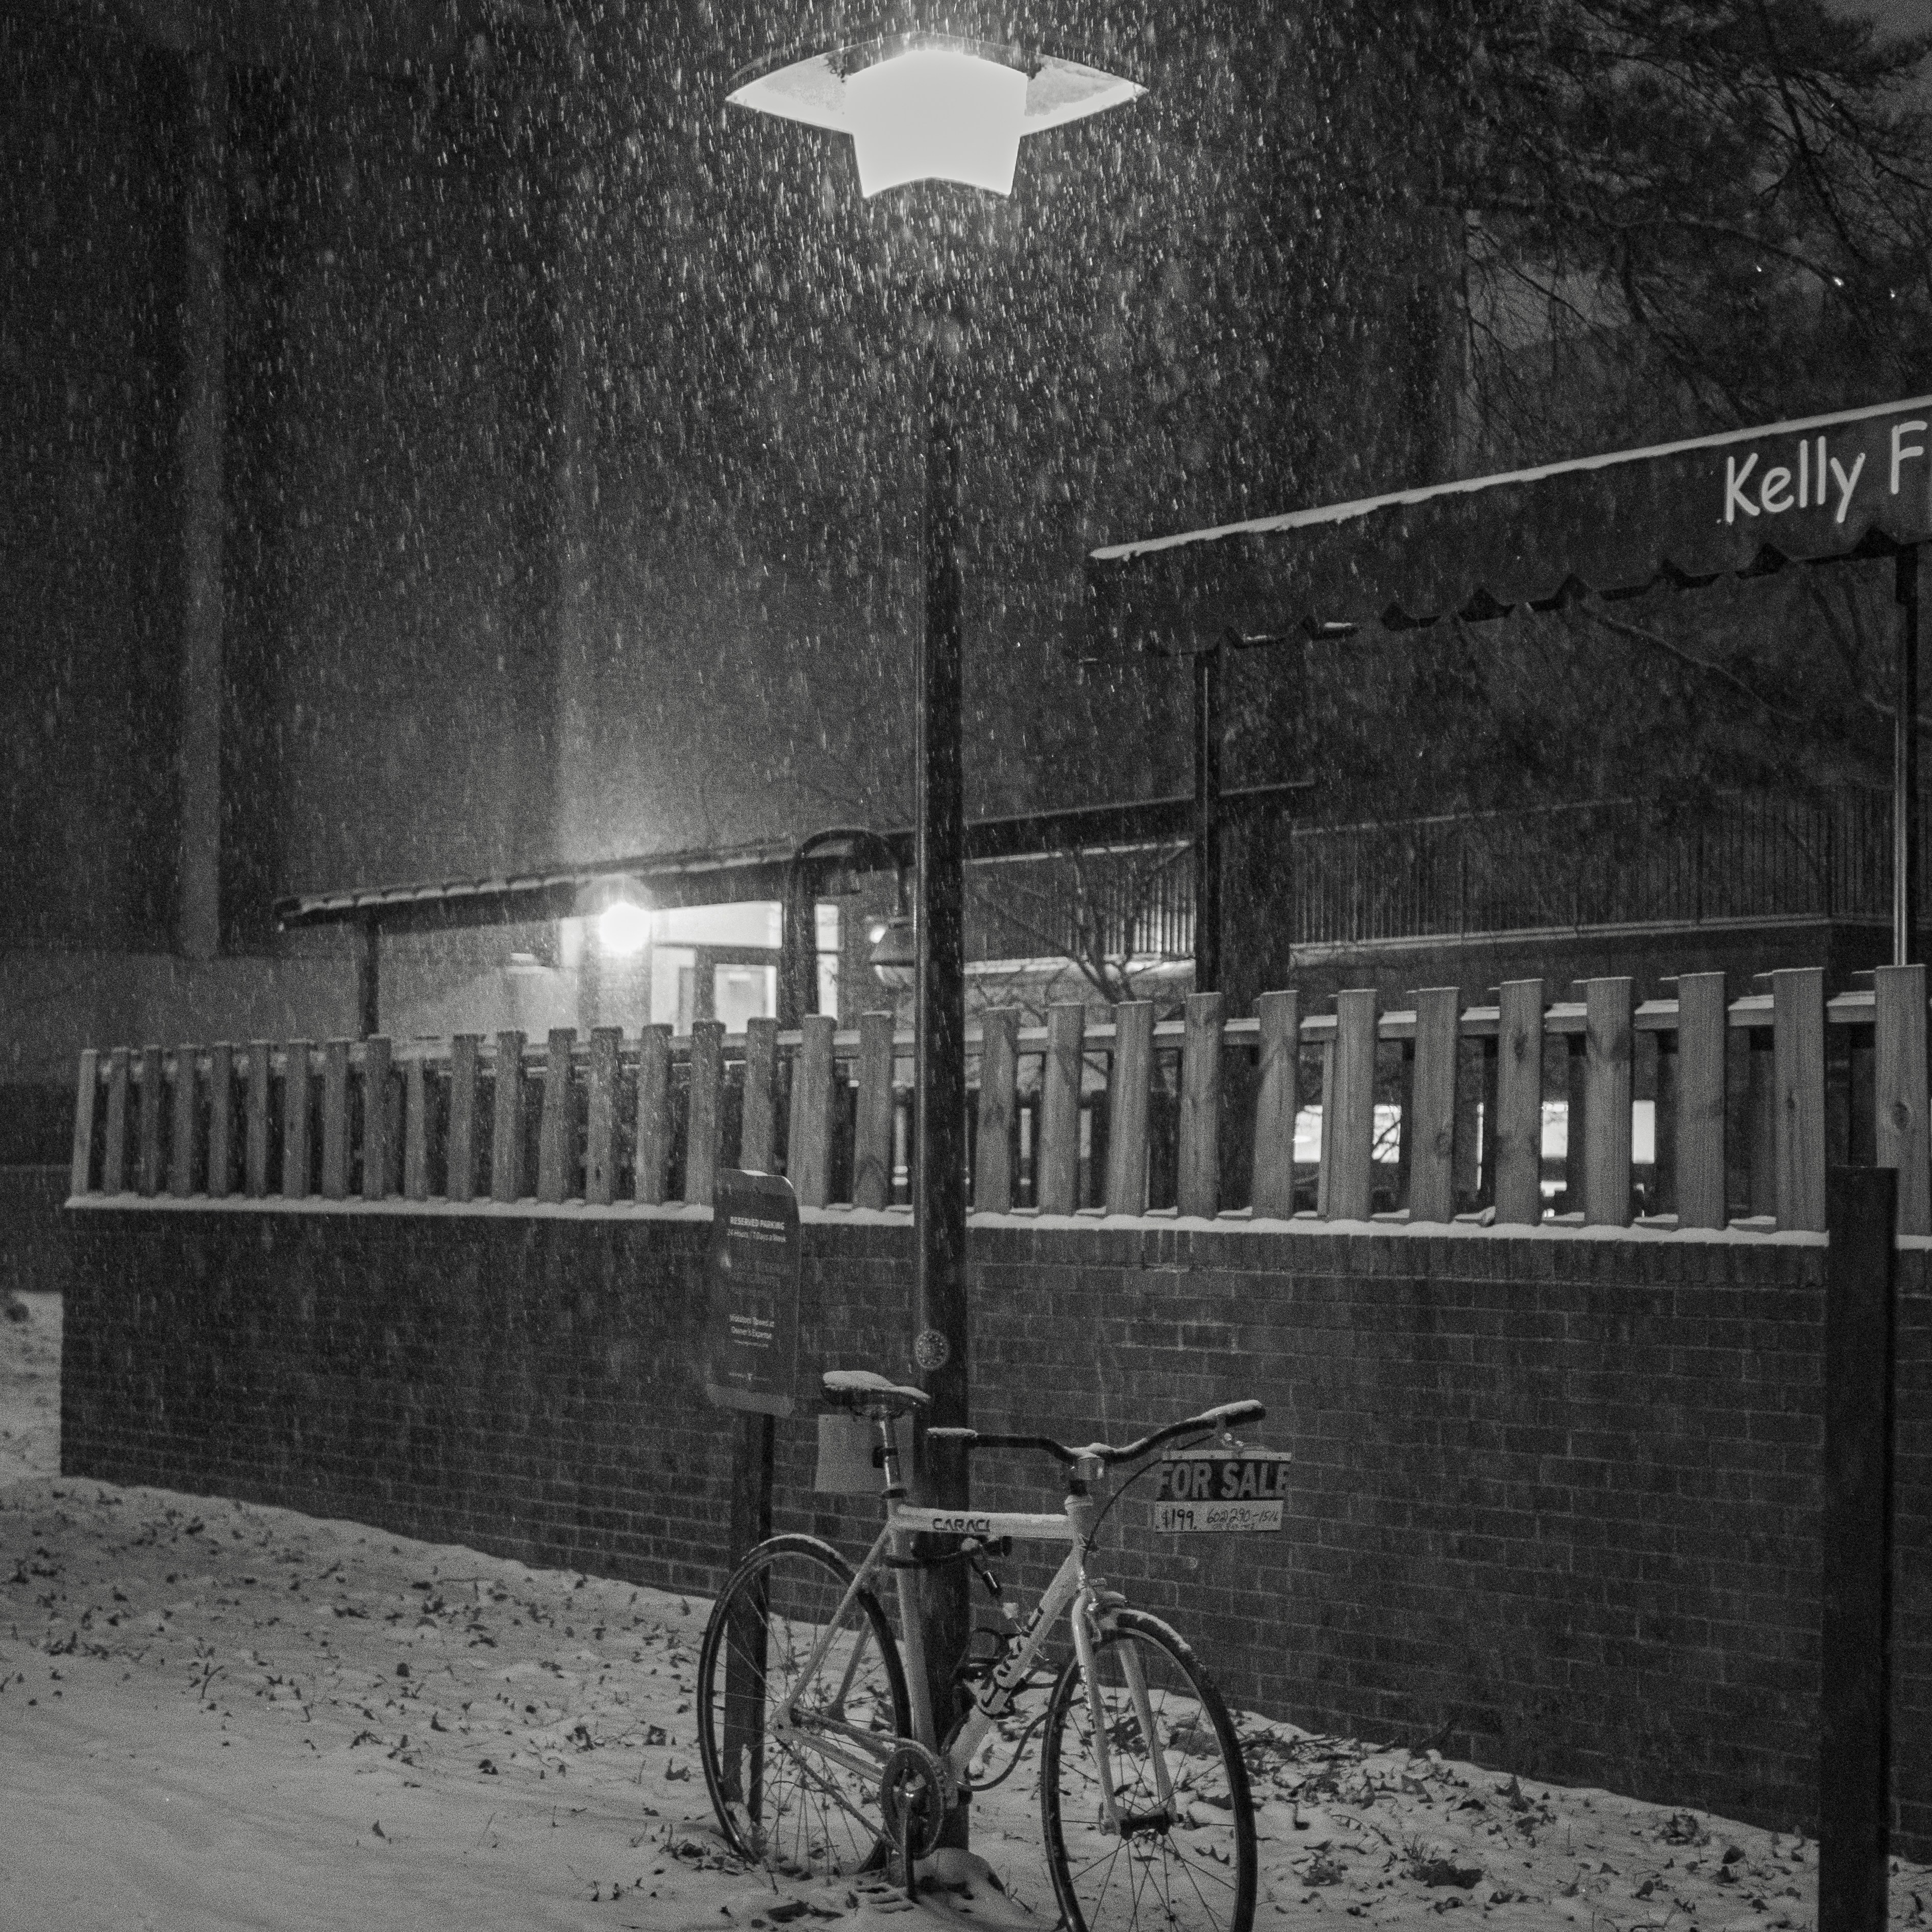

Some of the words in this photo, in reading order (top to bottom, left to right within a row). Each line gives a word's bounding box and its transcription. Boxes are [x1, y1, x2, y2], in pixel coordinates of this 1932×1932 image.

[1725, 435, 1866, 524] Kelly
[1890, 420, 1928, 496] F
[730, 1216, 759, 1227] RESERVED
[760, 1220, 785, 1230] PARKING
[1155, 1461, 1212, 1499] FOR
[1220, 1460, 1290, 1498] SALE
